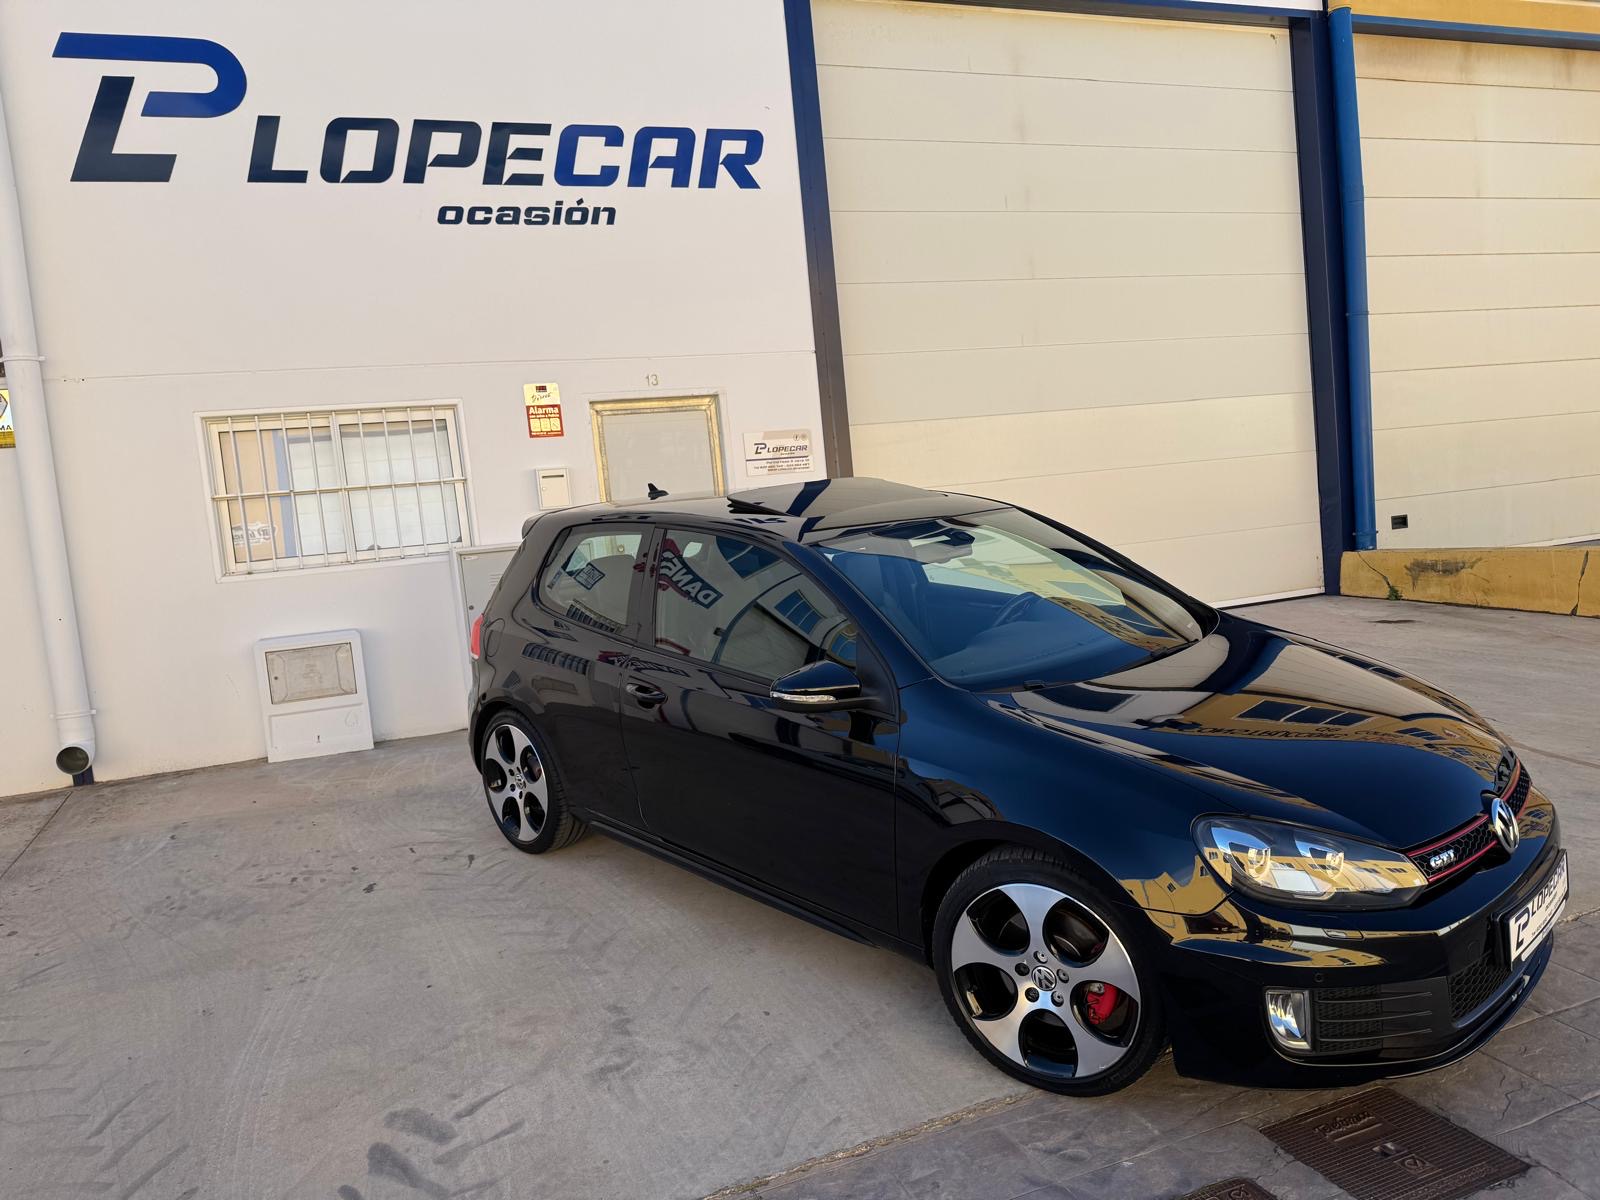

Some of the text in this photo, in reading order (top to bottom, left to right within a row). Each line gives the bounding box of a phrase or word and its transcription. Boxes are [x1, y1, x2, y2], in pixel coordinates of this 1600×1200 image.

[247, 115, 764, 189] LOPECAR
[437, 198, 616, 226] ocasión
[645, 373, 660, 387] 13
[529, 406, 560, 415] Alarma
[767, 444, 808, 453] LOPECAR
[1429, 848, 1457, 869] GTI
[1530, 856, 1566, 918] LOPECAR
